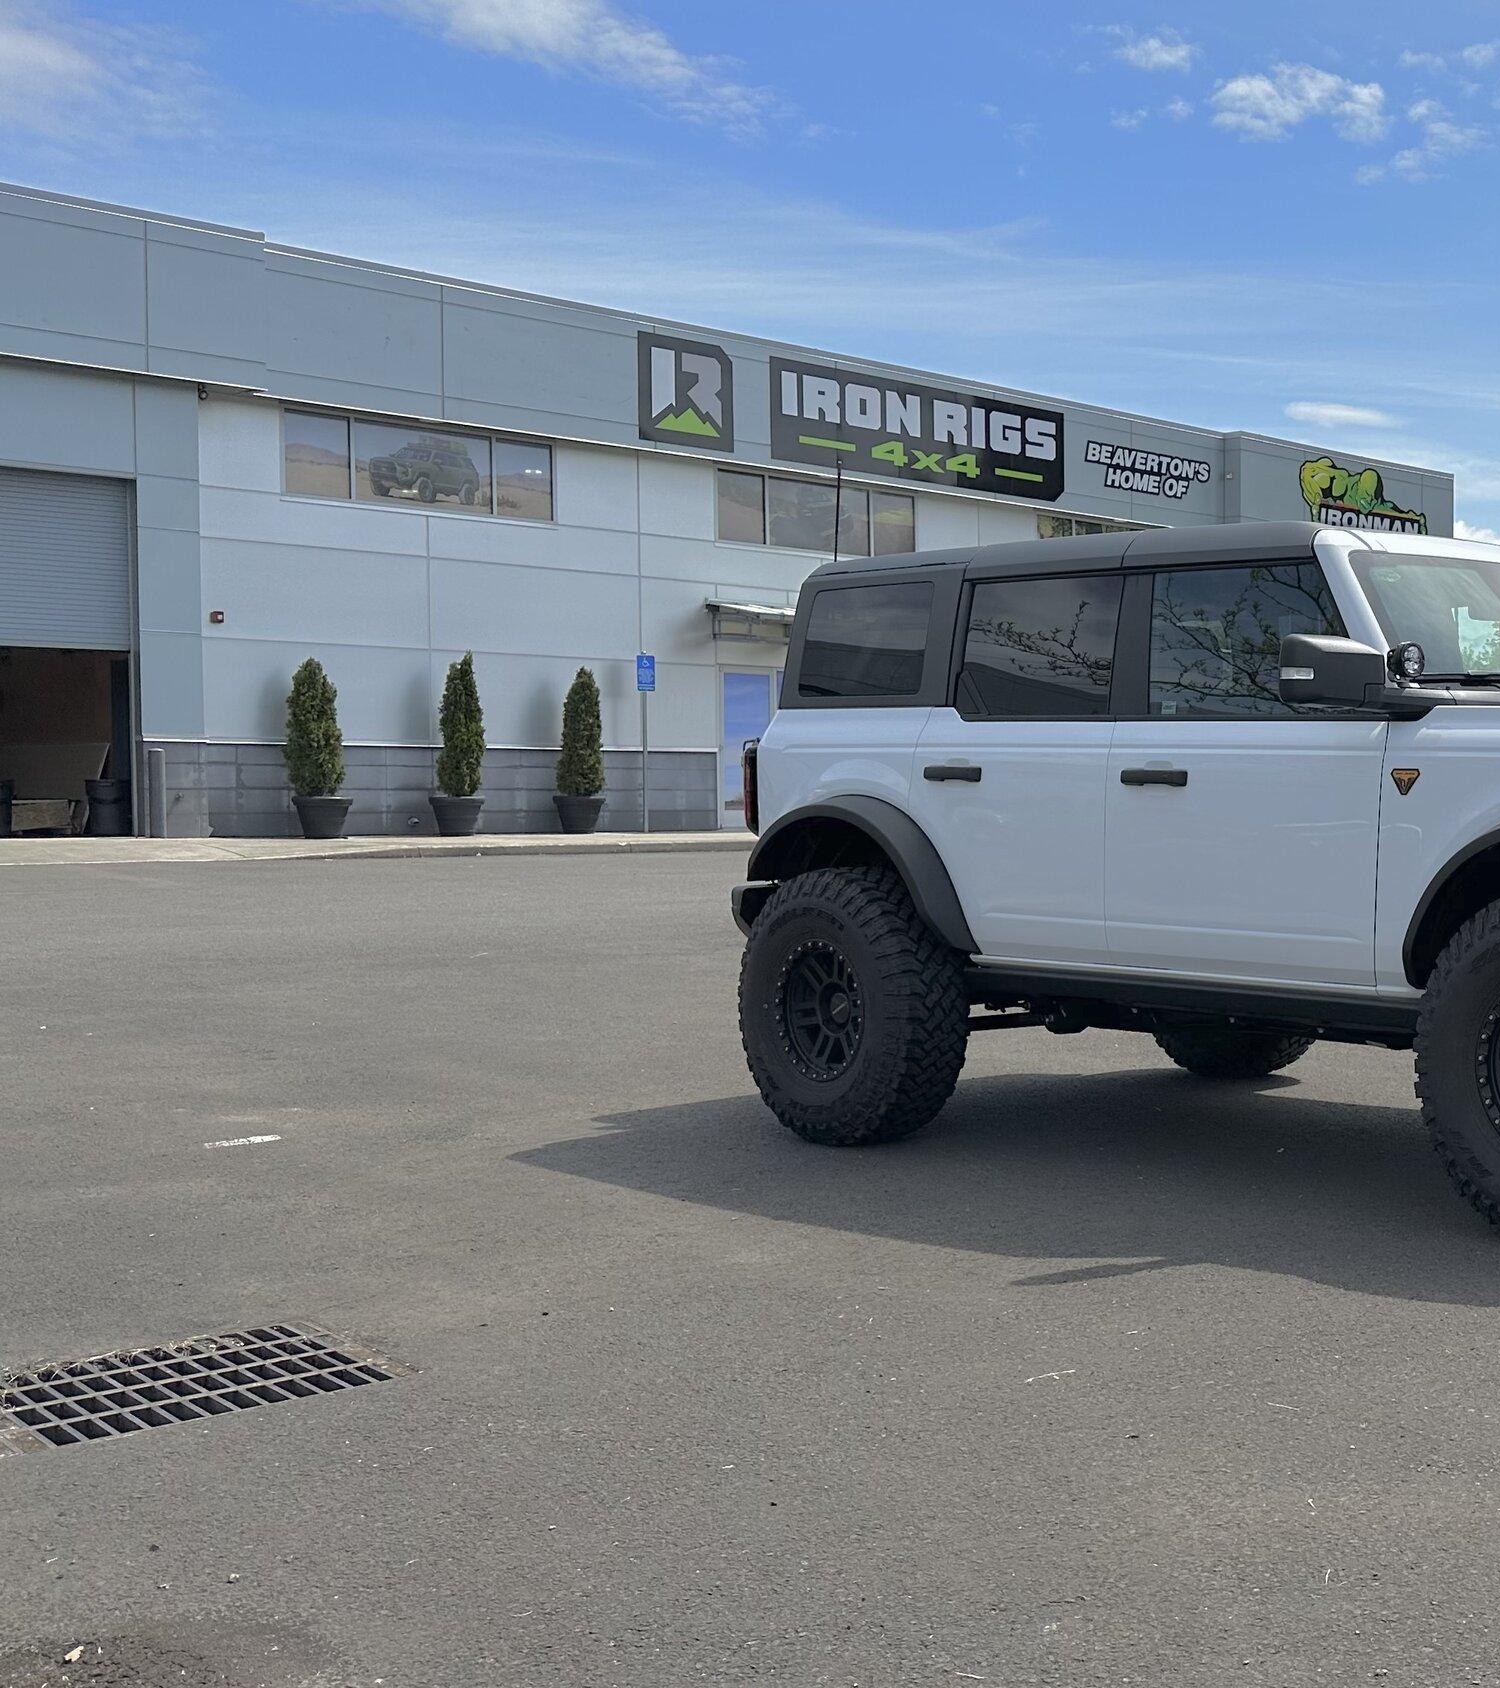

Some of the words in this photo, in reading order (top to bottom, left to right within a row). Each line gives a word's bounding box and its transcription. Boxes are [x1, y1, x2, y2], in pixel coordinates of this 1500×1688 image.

[781, 370, 921, 438] IRON
[933, 399, 1056, 461] RIGS
[1086, 442, 1210, 482] BEAVERTON'S
[1105, 467, 1160, 494] HOME
[1163, 478, 1189, 498] OF
[1320, 507, 1419, 533] IRONMAN
